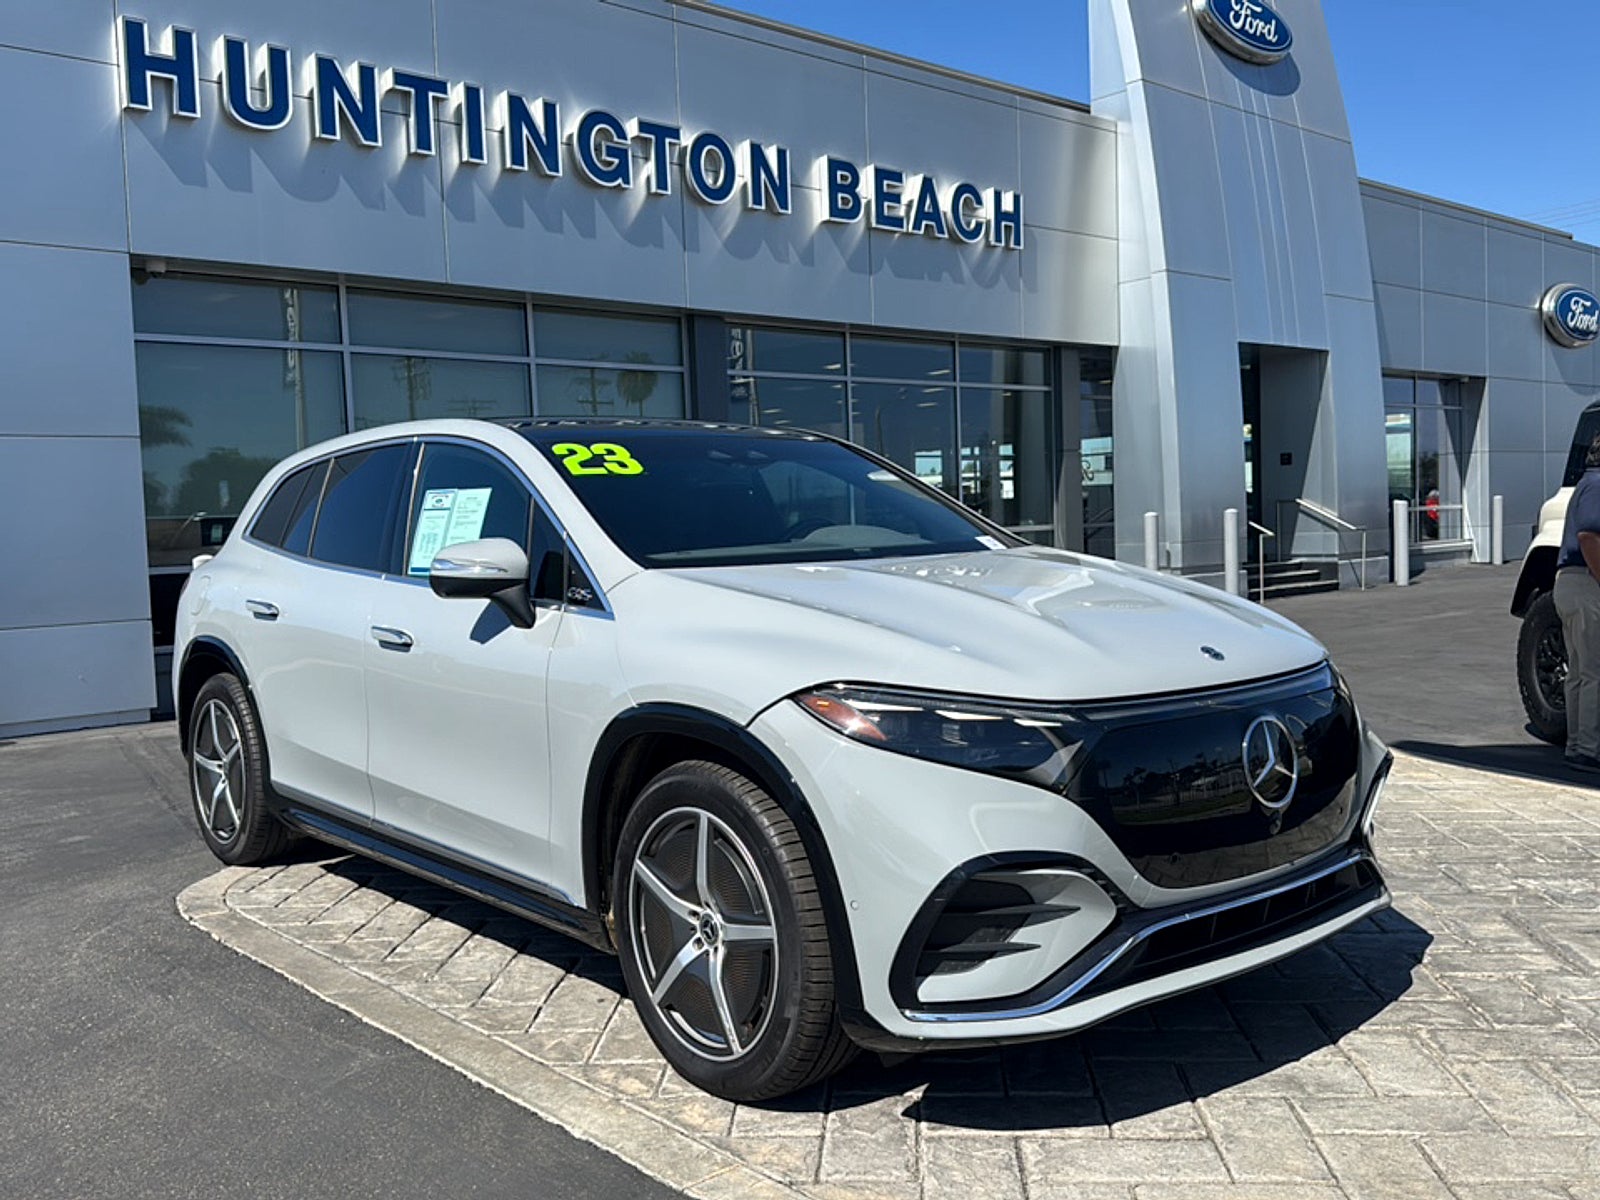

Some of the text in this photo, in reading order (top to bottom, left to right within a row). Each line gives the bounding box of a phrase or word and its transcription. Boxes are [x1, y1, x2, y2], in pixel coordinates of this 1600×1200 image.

[1229, 0, 1278, 42] Ford
[118, 15, 1023, 249] HUNTINGTON BEACH
[1567, 296, 1599, 332] Ford
[552, 443, 644, 475] 23
